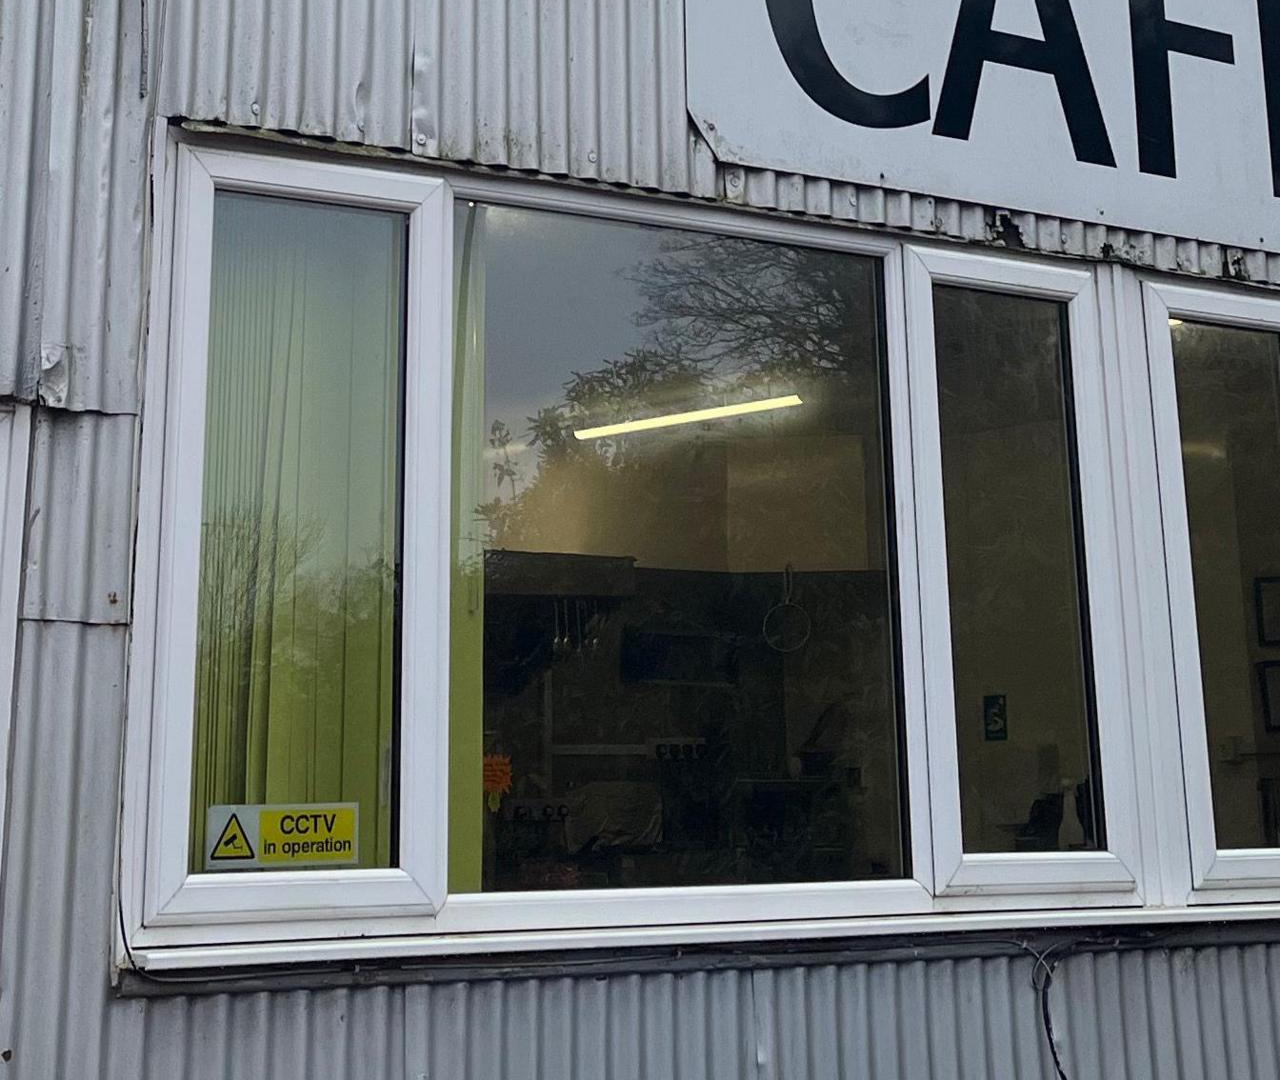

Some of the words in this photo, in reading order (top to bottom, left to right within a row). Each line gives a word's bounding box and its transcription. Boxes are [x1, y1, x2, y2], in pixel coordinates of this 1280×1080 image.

[280, 813, 336, 834] CCTV
[263, 839, 276, 855] in
[282, 837, 351, 857] operation
